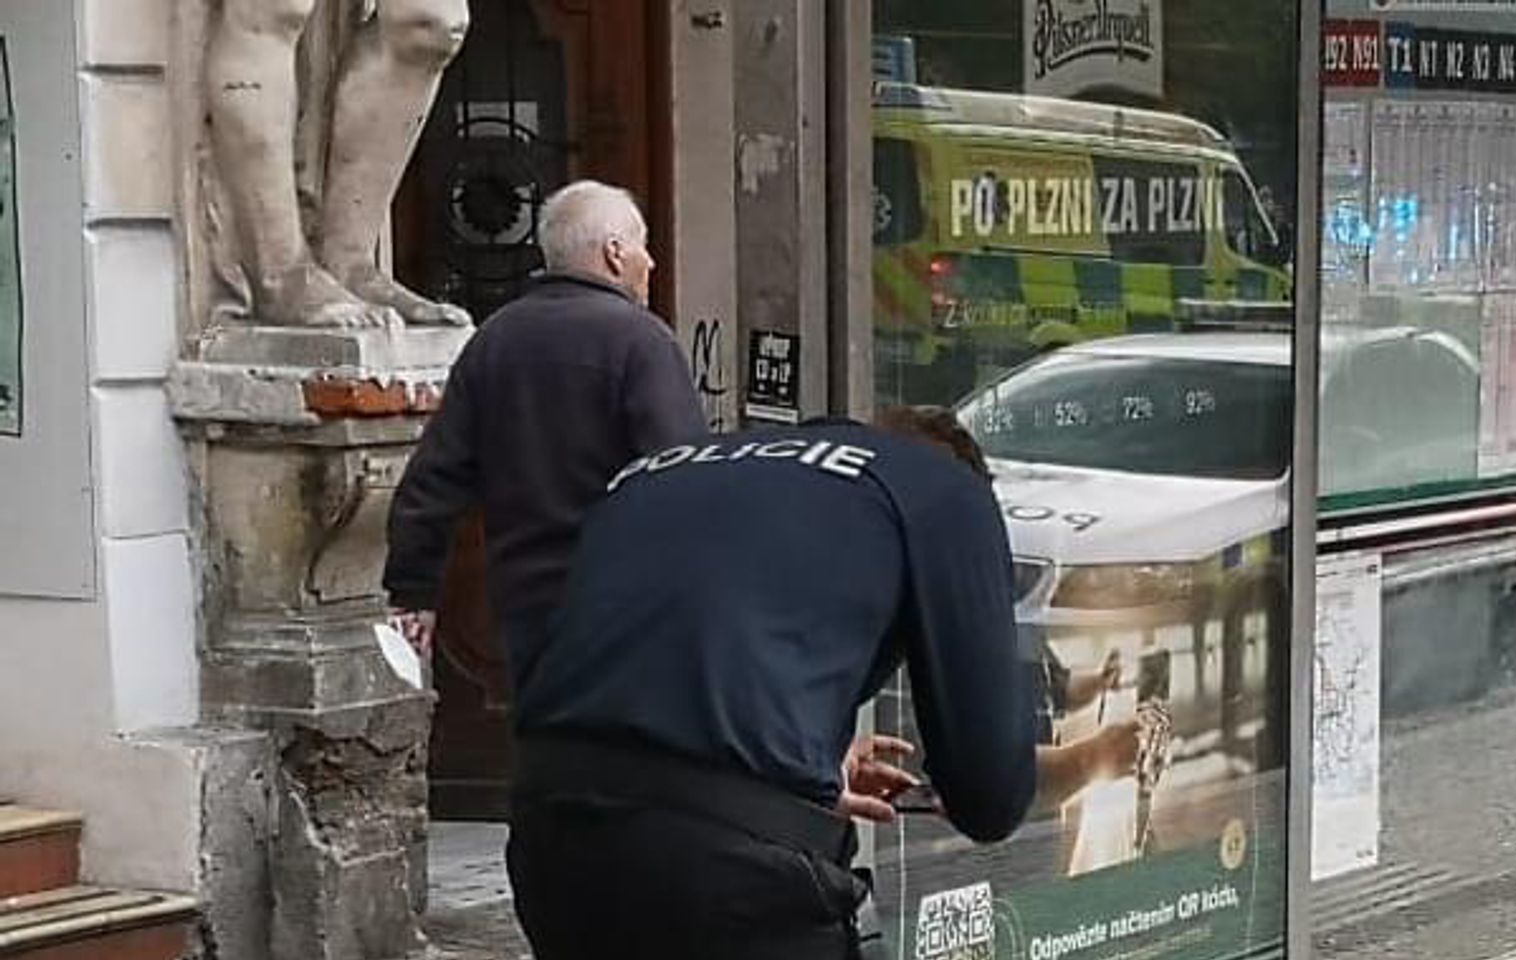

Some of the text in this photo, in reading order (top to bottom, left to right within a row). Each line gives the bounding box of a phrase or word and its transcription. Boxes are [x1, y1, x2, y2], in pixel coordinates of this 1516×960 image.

[1353, 34, 1380, 71] N91
[1388, 36, 1413, 72] T1
[1419, 40, 1438, 77] N1
[1447, 41, 1464, 78] N2
[1472, 44, 1490, 80] N3
[1008, 177, 1092, 236] PLZNI
[1102, 177, 1138, 234] ZA
[607, 439, 876, 492] POLICIE
[1110, 902, 1176, 939] načtením
[1178, 893, 1199, 919] QR
